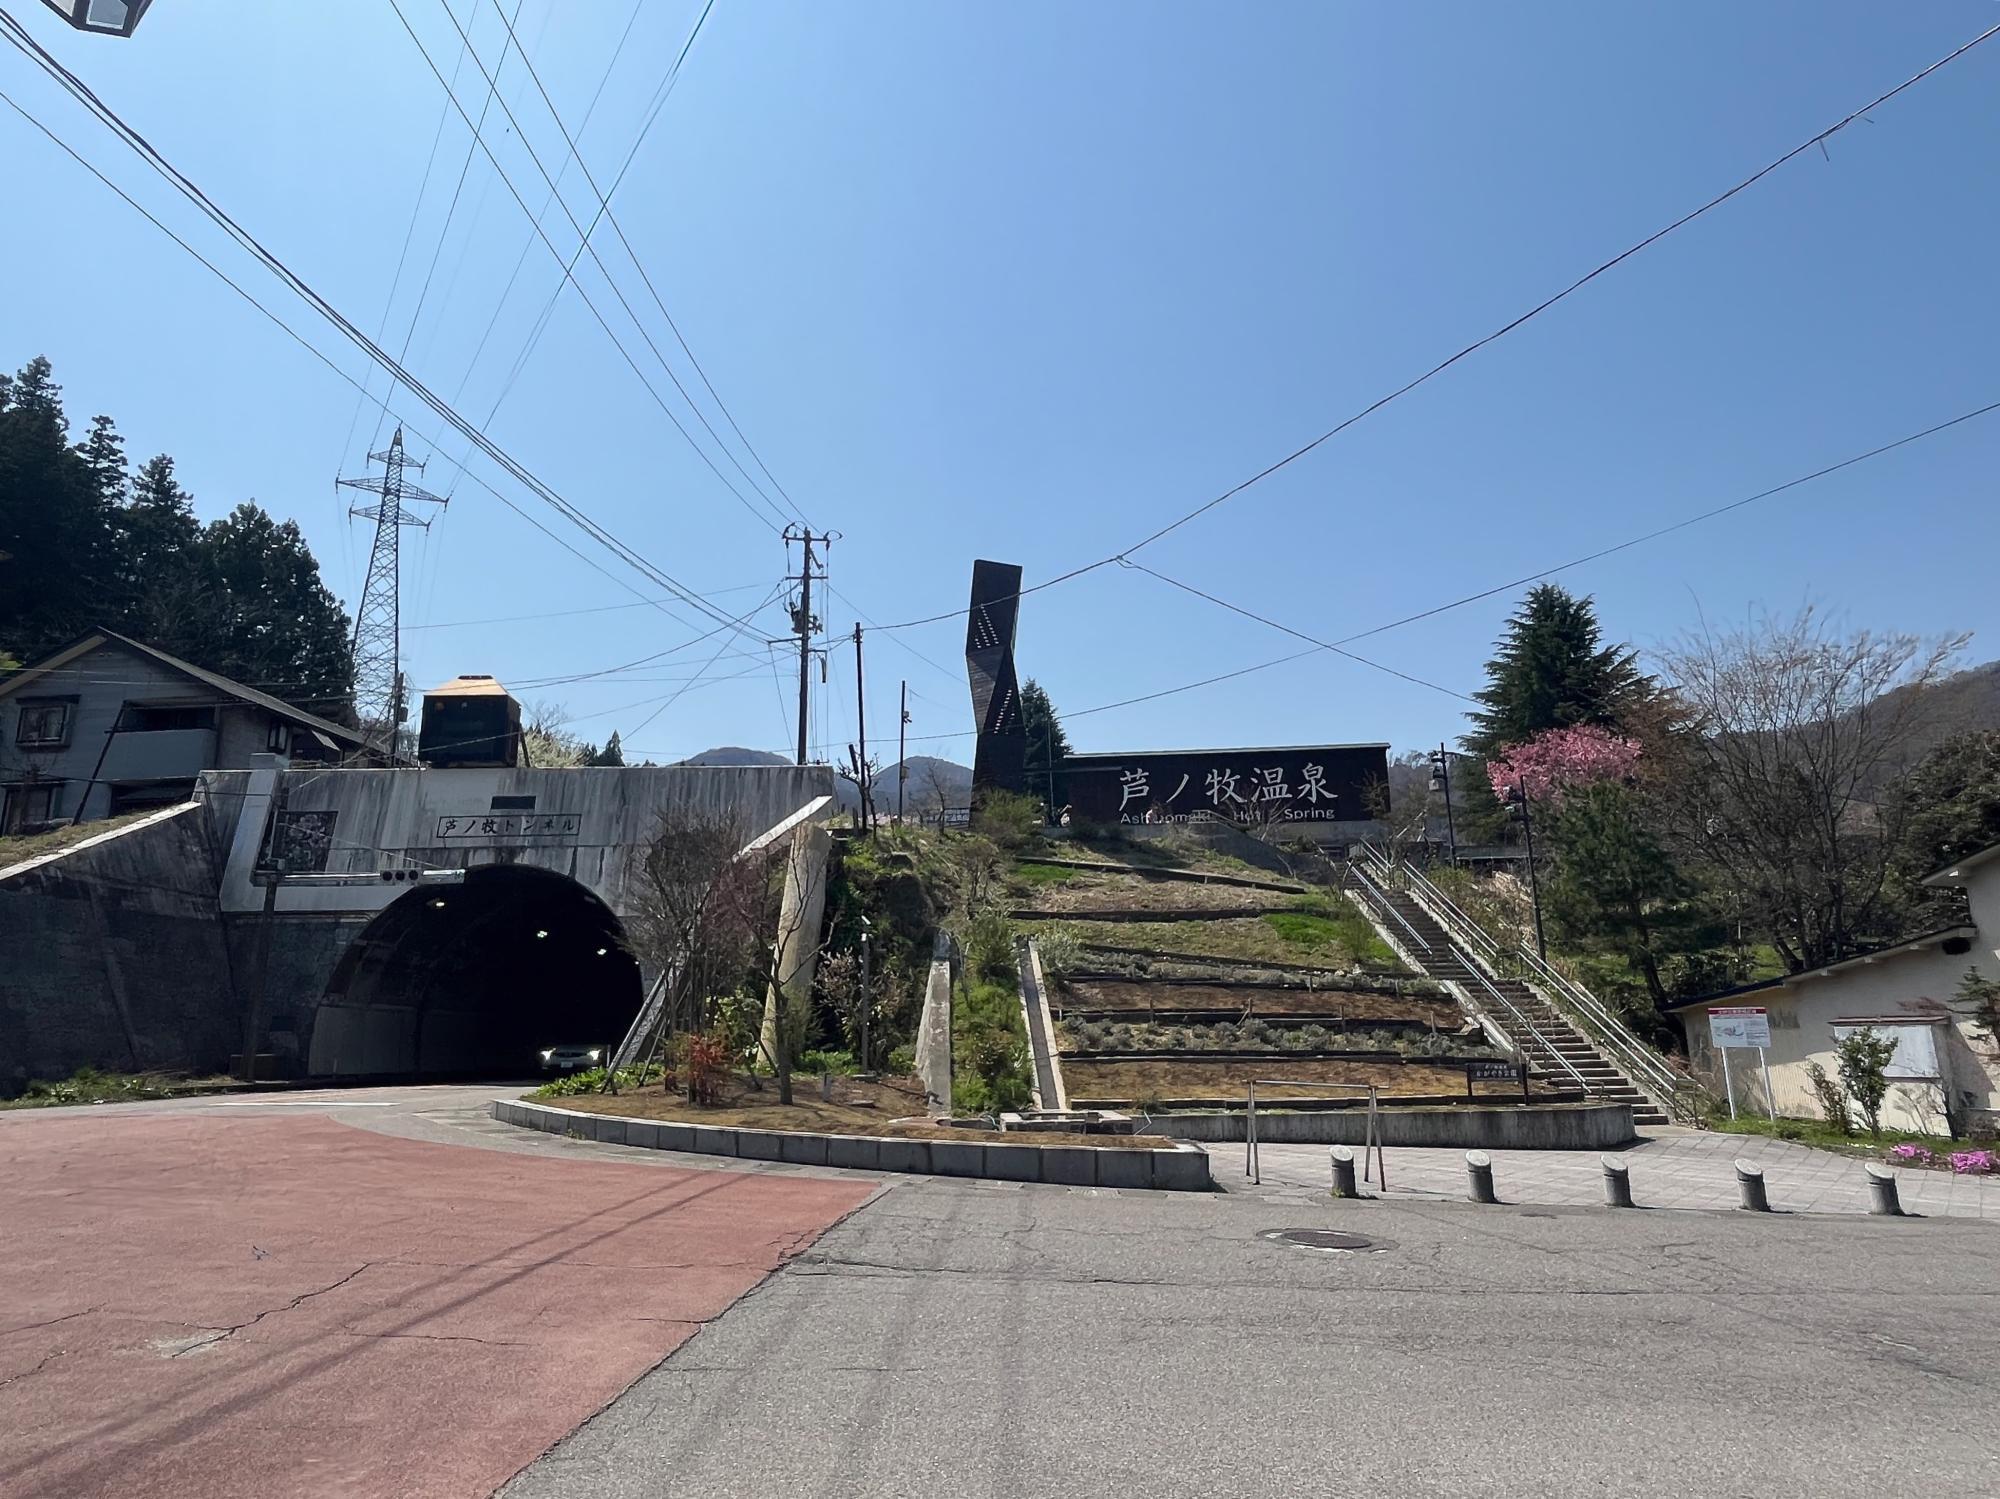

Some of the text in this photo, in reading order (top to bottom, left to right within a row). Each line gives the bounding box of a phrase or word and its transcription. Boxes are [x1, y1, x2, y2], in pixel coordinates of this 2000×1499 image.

[1118, 762, 1338, 811] 芦ノ牧温泉
[1284, 807, 1335, 820] Spring
[443, 818, 574, 836] 芦ノ牧トンネル
